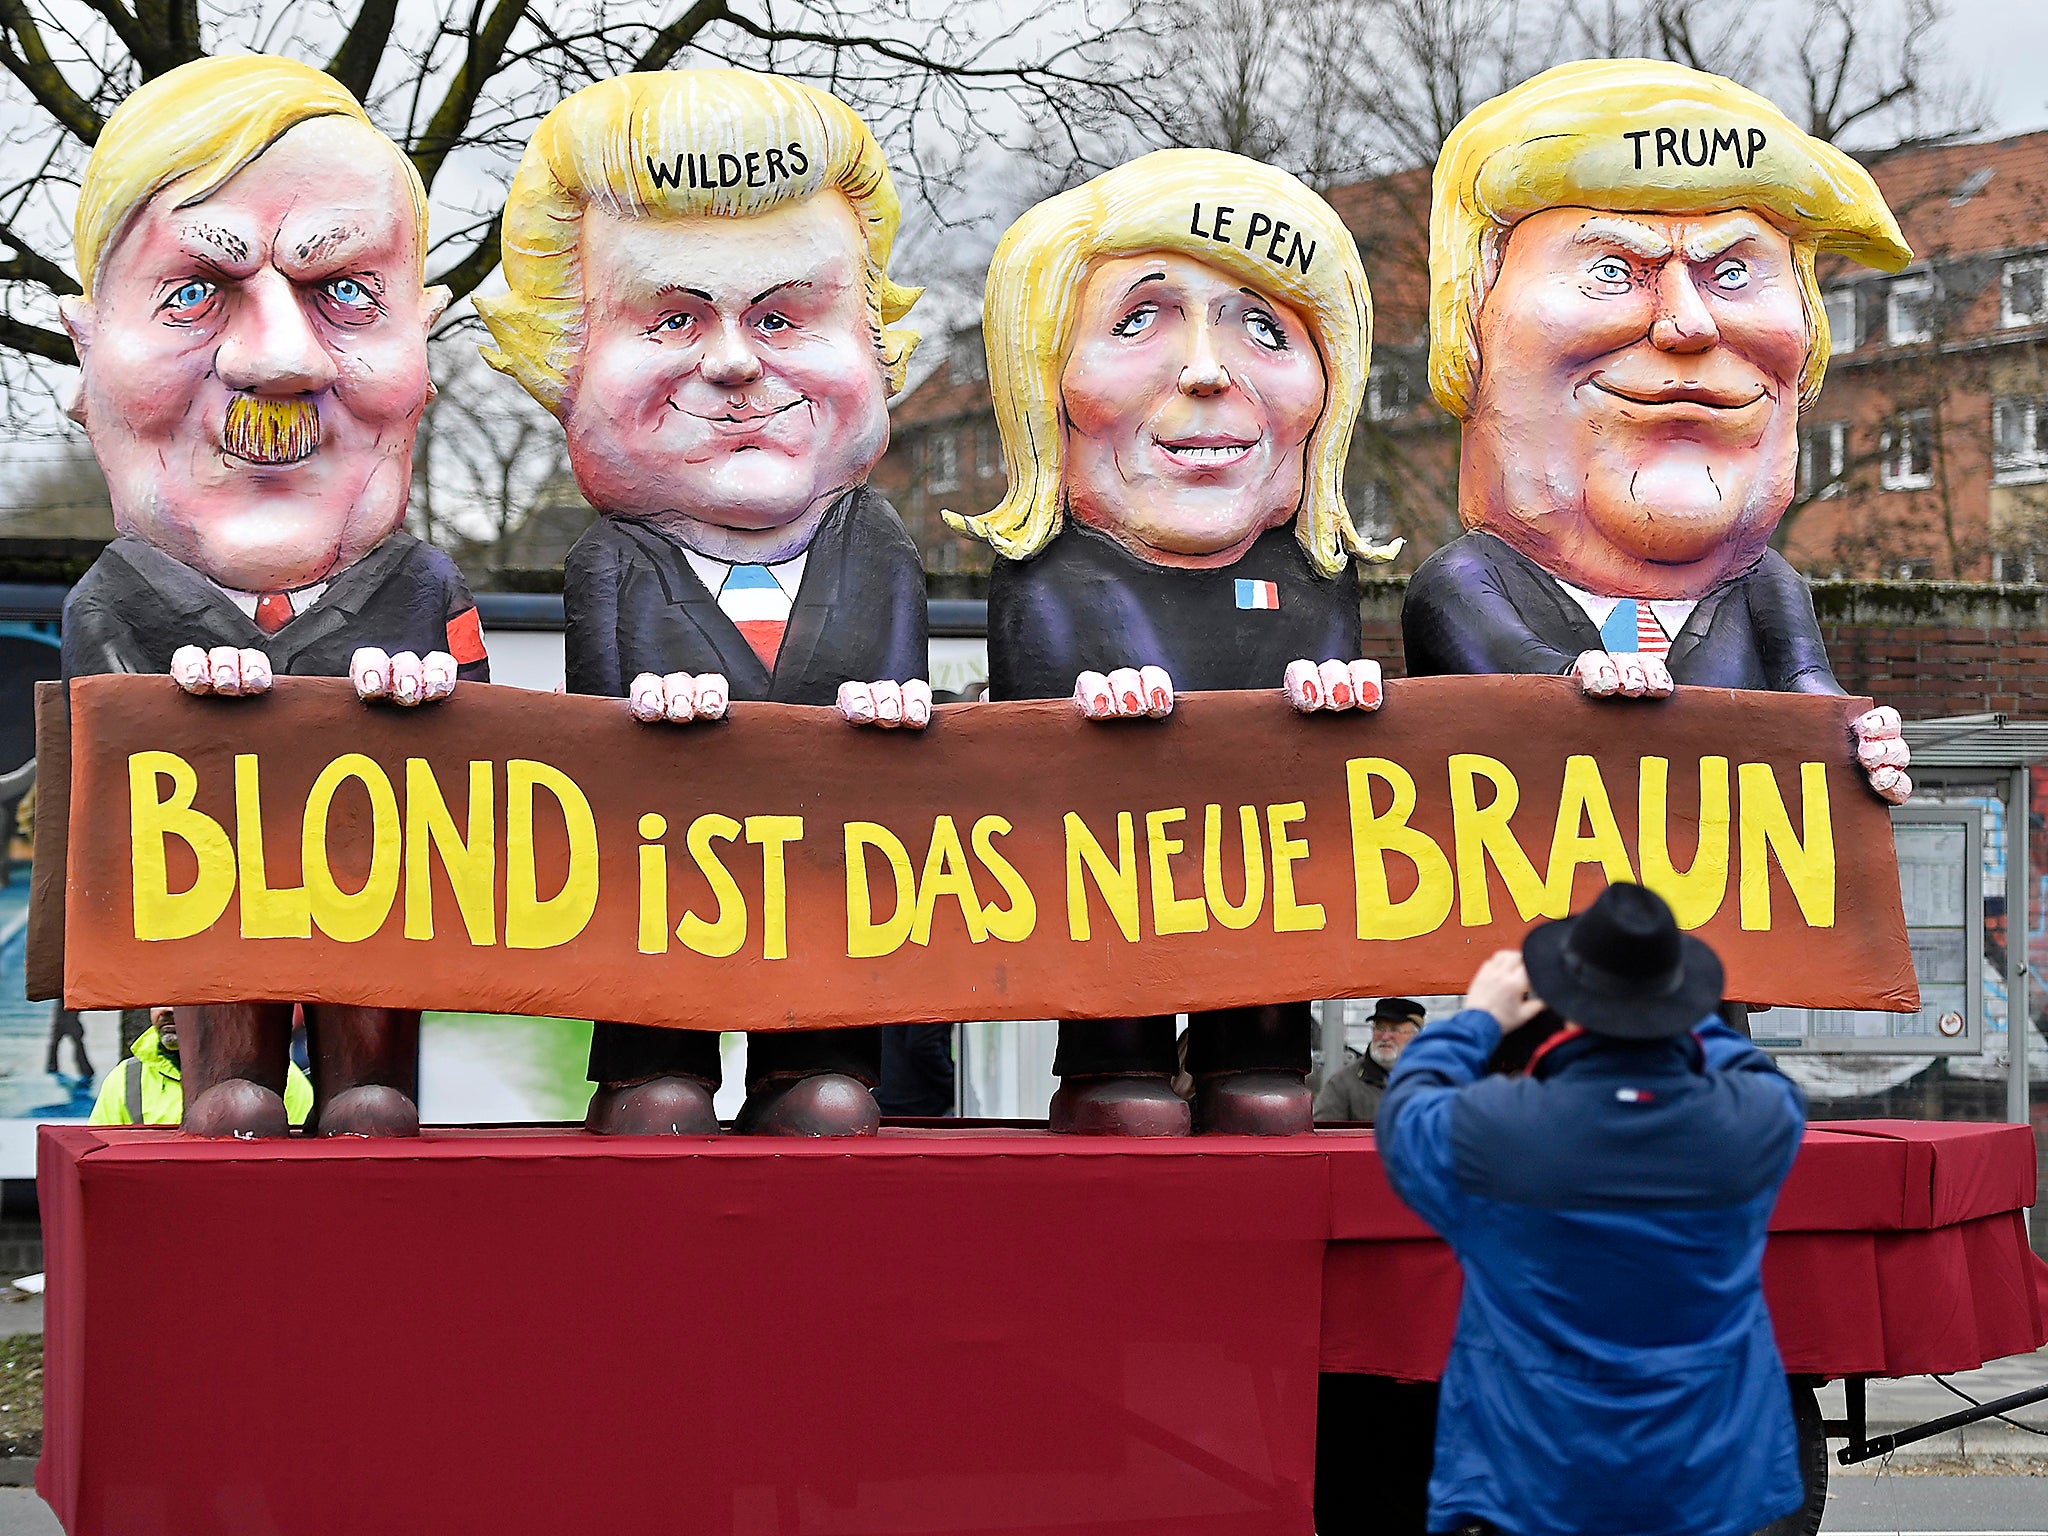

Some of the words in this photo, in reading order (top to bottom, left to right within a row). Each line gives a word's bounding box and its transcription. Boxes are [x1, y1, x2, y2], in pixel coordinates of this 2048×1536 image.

[647, 141, 810, 190] WILDERS
[1623, 127, 1768, 170] TRUMP
[1190, 202, 1235, 244] LE
[1244, 212, 1317, 275] PEN
[129, 751, 598, 949] BLOND
[845, 815, 1037, 958] DAS
[1064, 802, 1326, 943] NEUE
[1346, 756, 1836, 941] BRAUN
